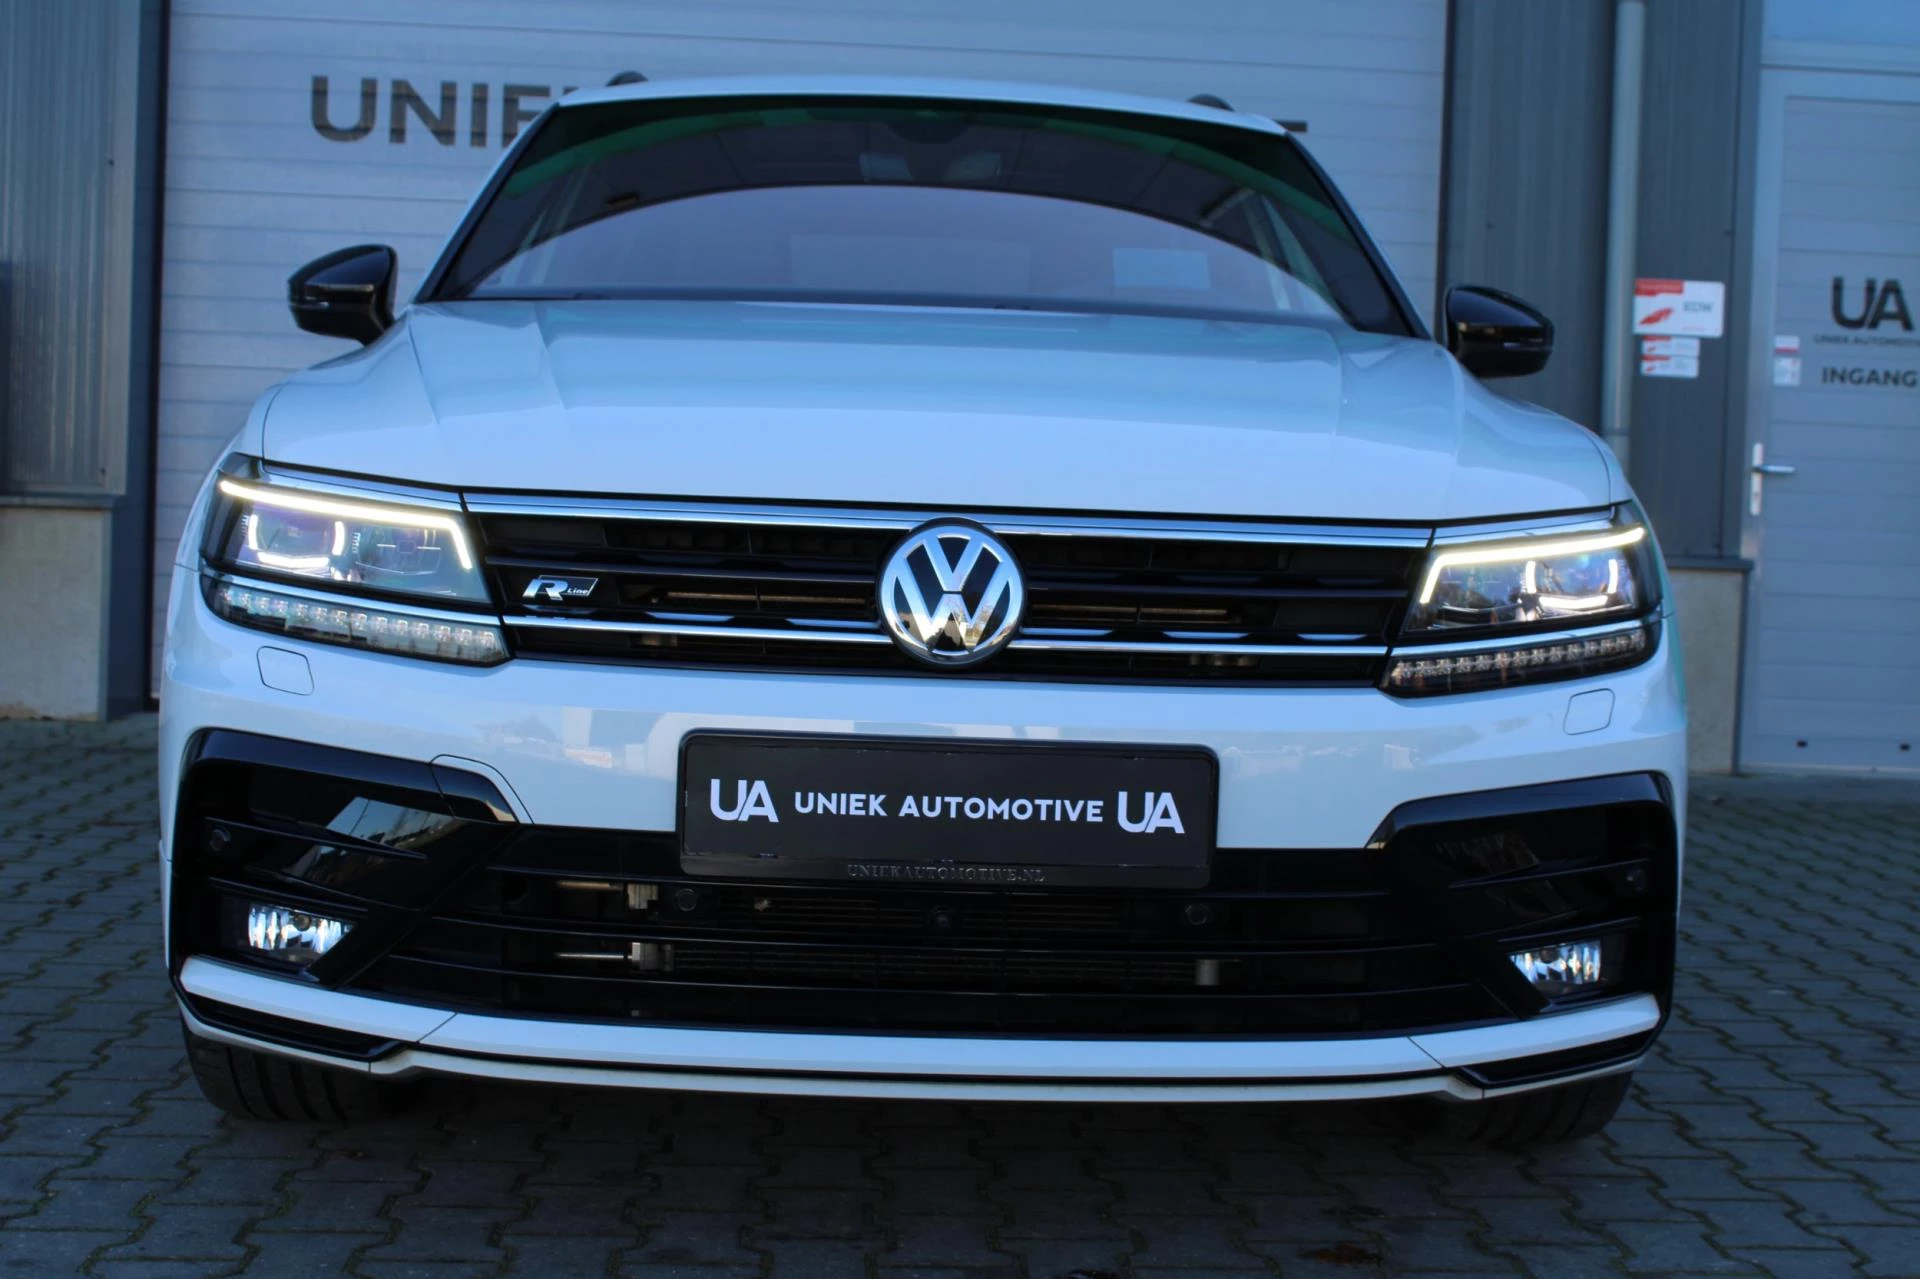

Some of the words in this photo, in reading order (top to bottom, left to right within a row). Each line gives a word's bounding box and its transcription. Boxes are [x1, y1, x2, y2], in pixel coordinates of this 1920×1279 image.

[312, 76, 580, 148] UNIE
[1832, 277, 1914, 331] UA
[1821, 366, 1919, 387] INGANG
[709, 778, 779, 823] UA
[794, 791, 888, 817] UNIEK
[899, 795, 1104, 822] AUTOMOTIVE
[1117, 791, 1185, 834] UA
